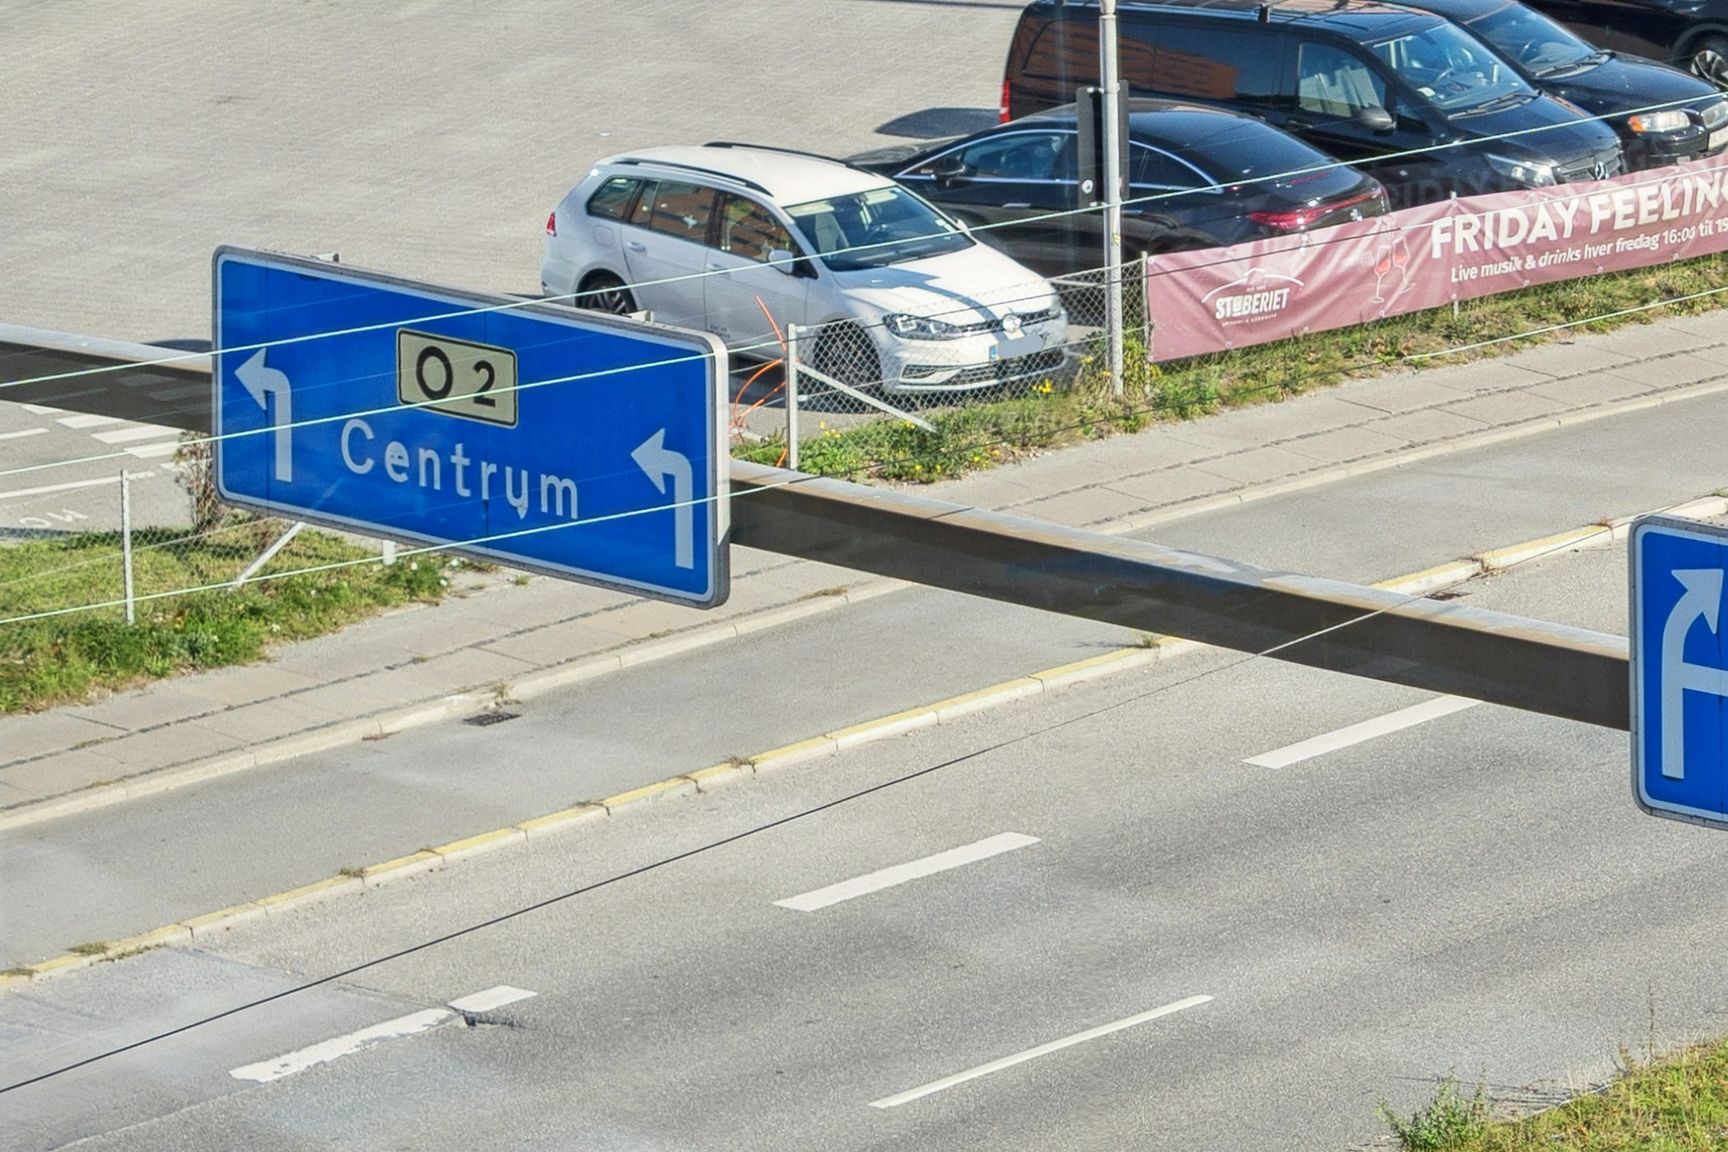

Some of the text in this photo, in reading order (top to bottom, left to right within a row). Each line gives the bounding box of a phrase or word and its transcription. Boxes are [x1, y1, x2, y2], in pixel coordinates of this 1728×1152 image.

[1431, 196, 1580, 259] FRIDAY
[1451, 265, 1477, 283] Live
[1481, 257, 1522, 277] musik
[1525, 254, 1536, 270] &
[1538, 249, 1581, 267] drinks
[1584, 243, 1614, 259] hver
[1616, 232, 1660, 252] fredag
[1699, 219, 1713, 236] til
